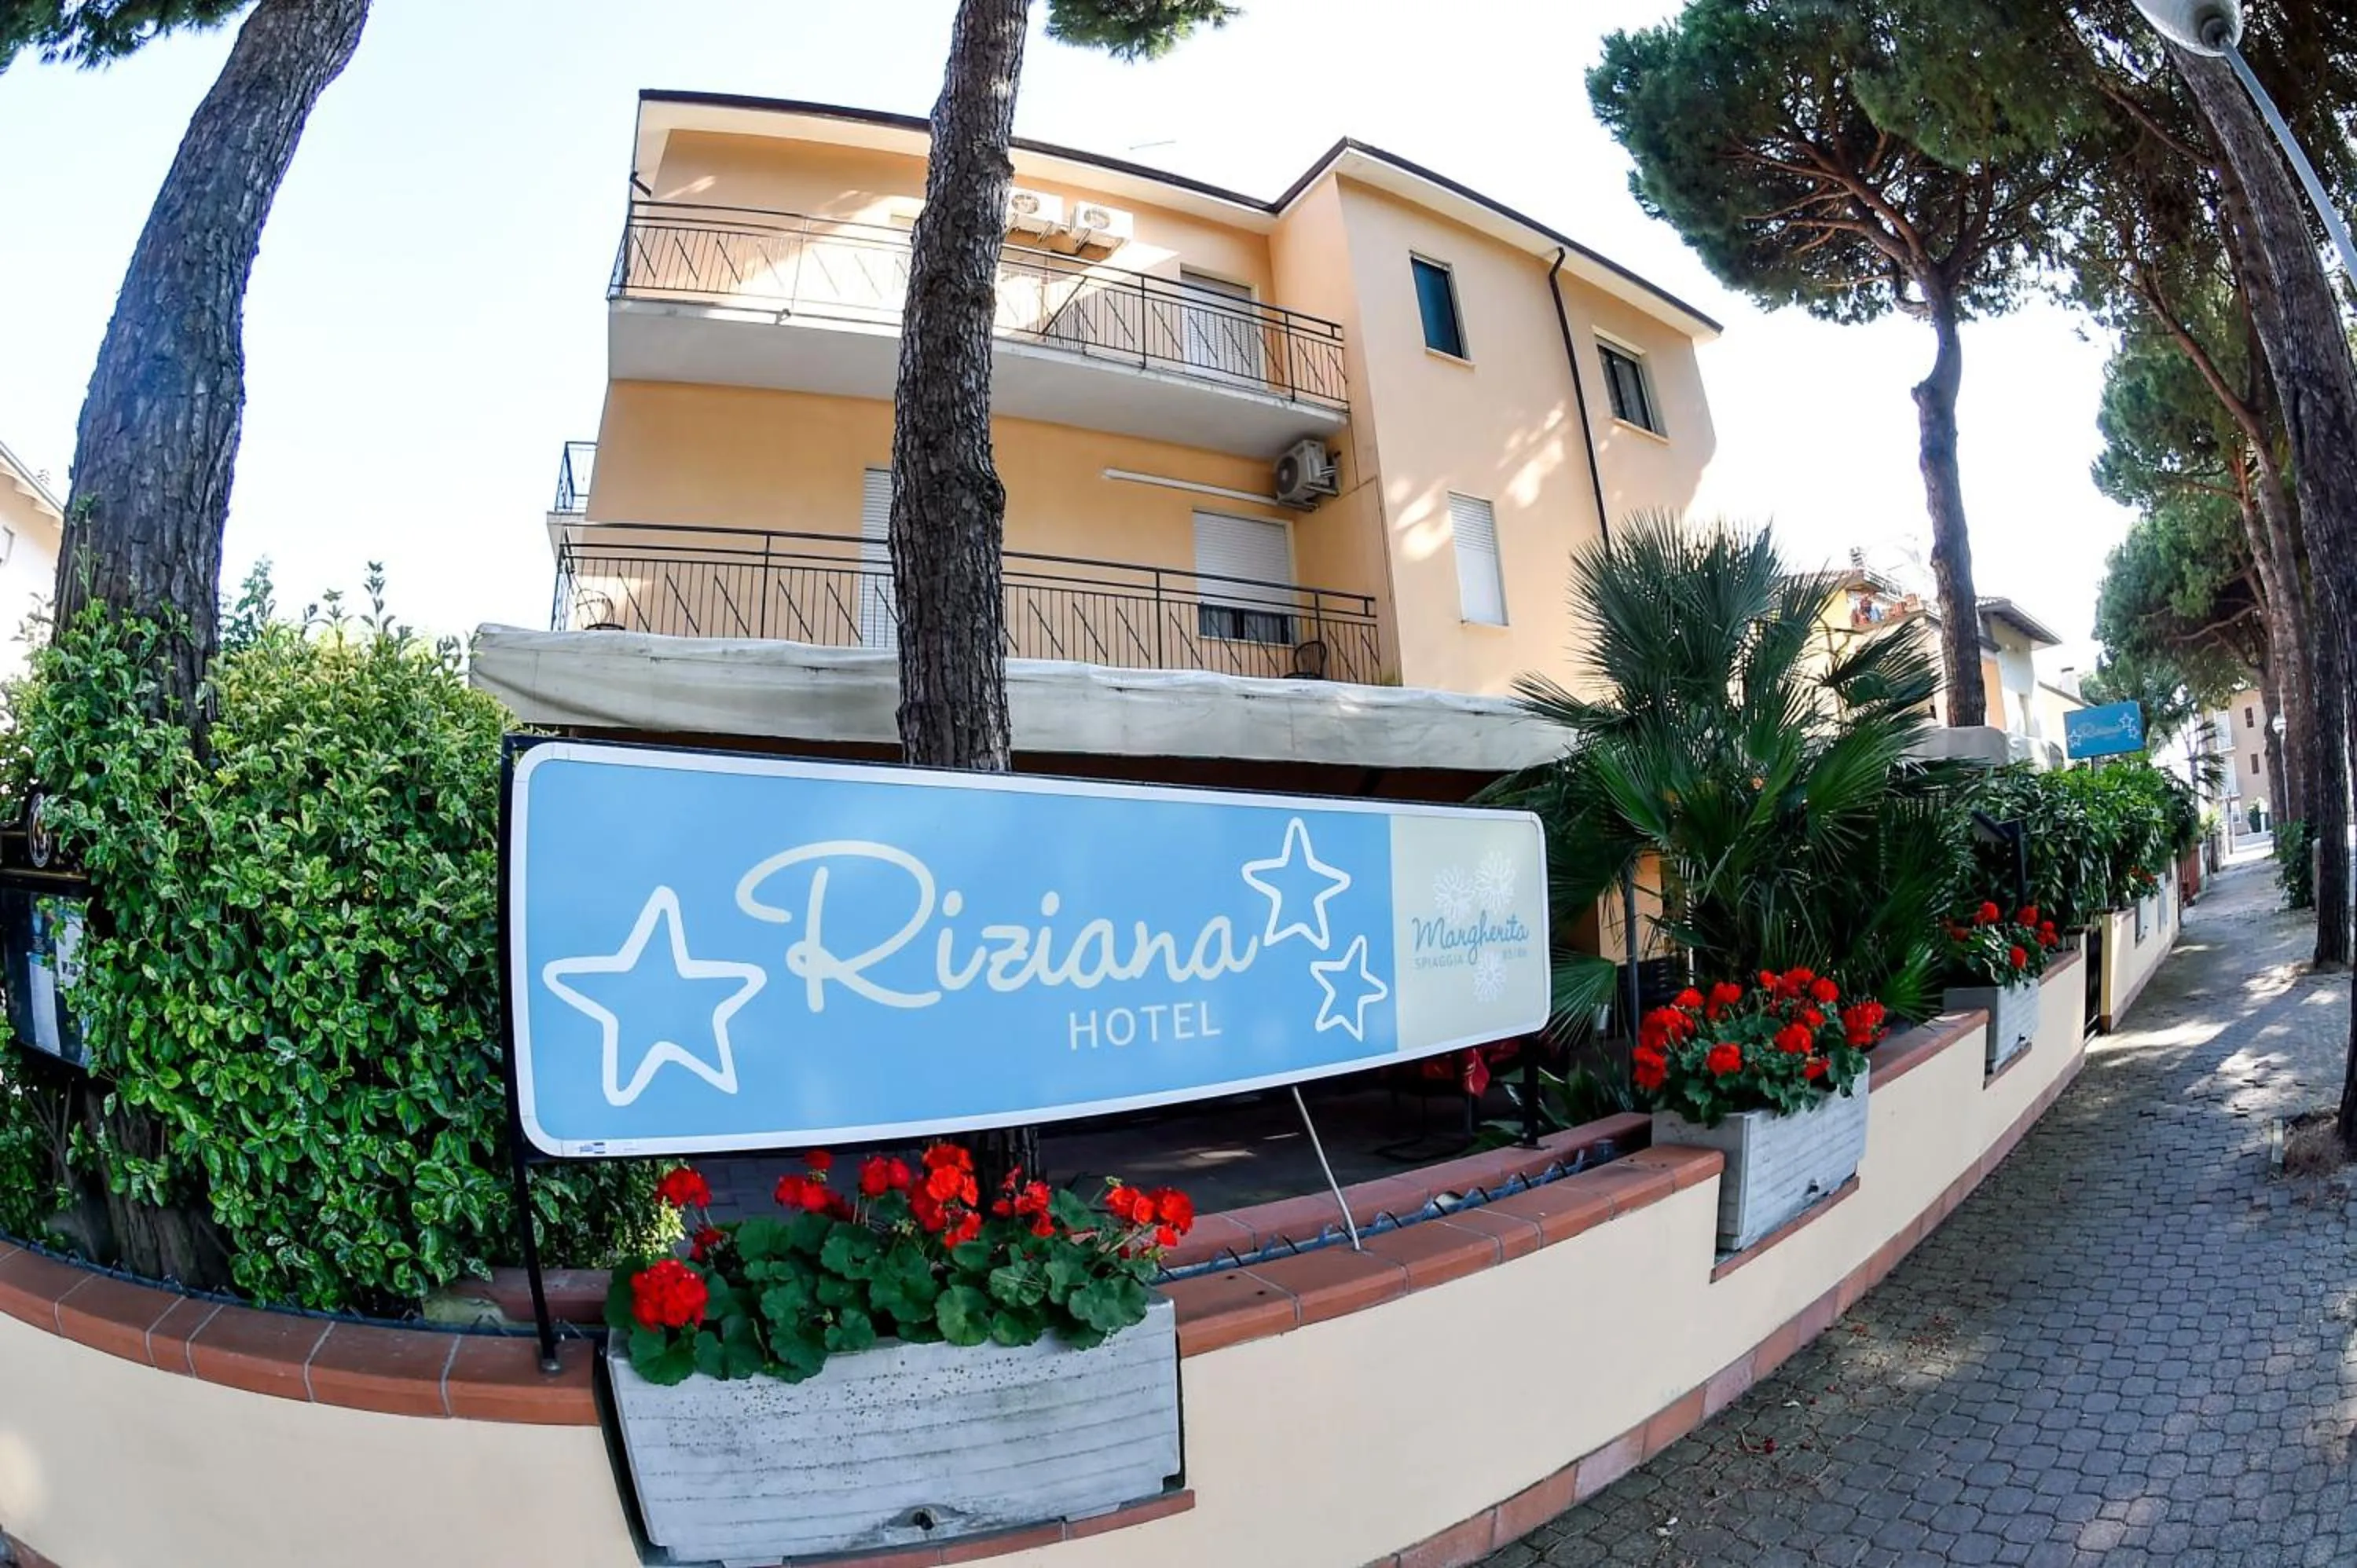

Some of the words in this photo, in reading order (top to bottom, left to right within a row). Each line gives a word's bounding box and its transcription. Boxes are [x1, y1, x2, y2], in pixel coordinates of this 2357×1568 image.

[735, 839, 1258, 1013] Riziana
[1412, 910, 1529, 965] Margherita
[1413, 953, 1464, 970] SPIAGGIA
[1069, 1000, 1222, 1050] HOTEL
